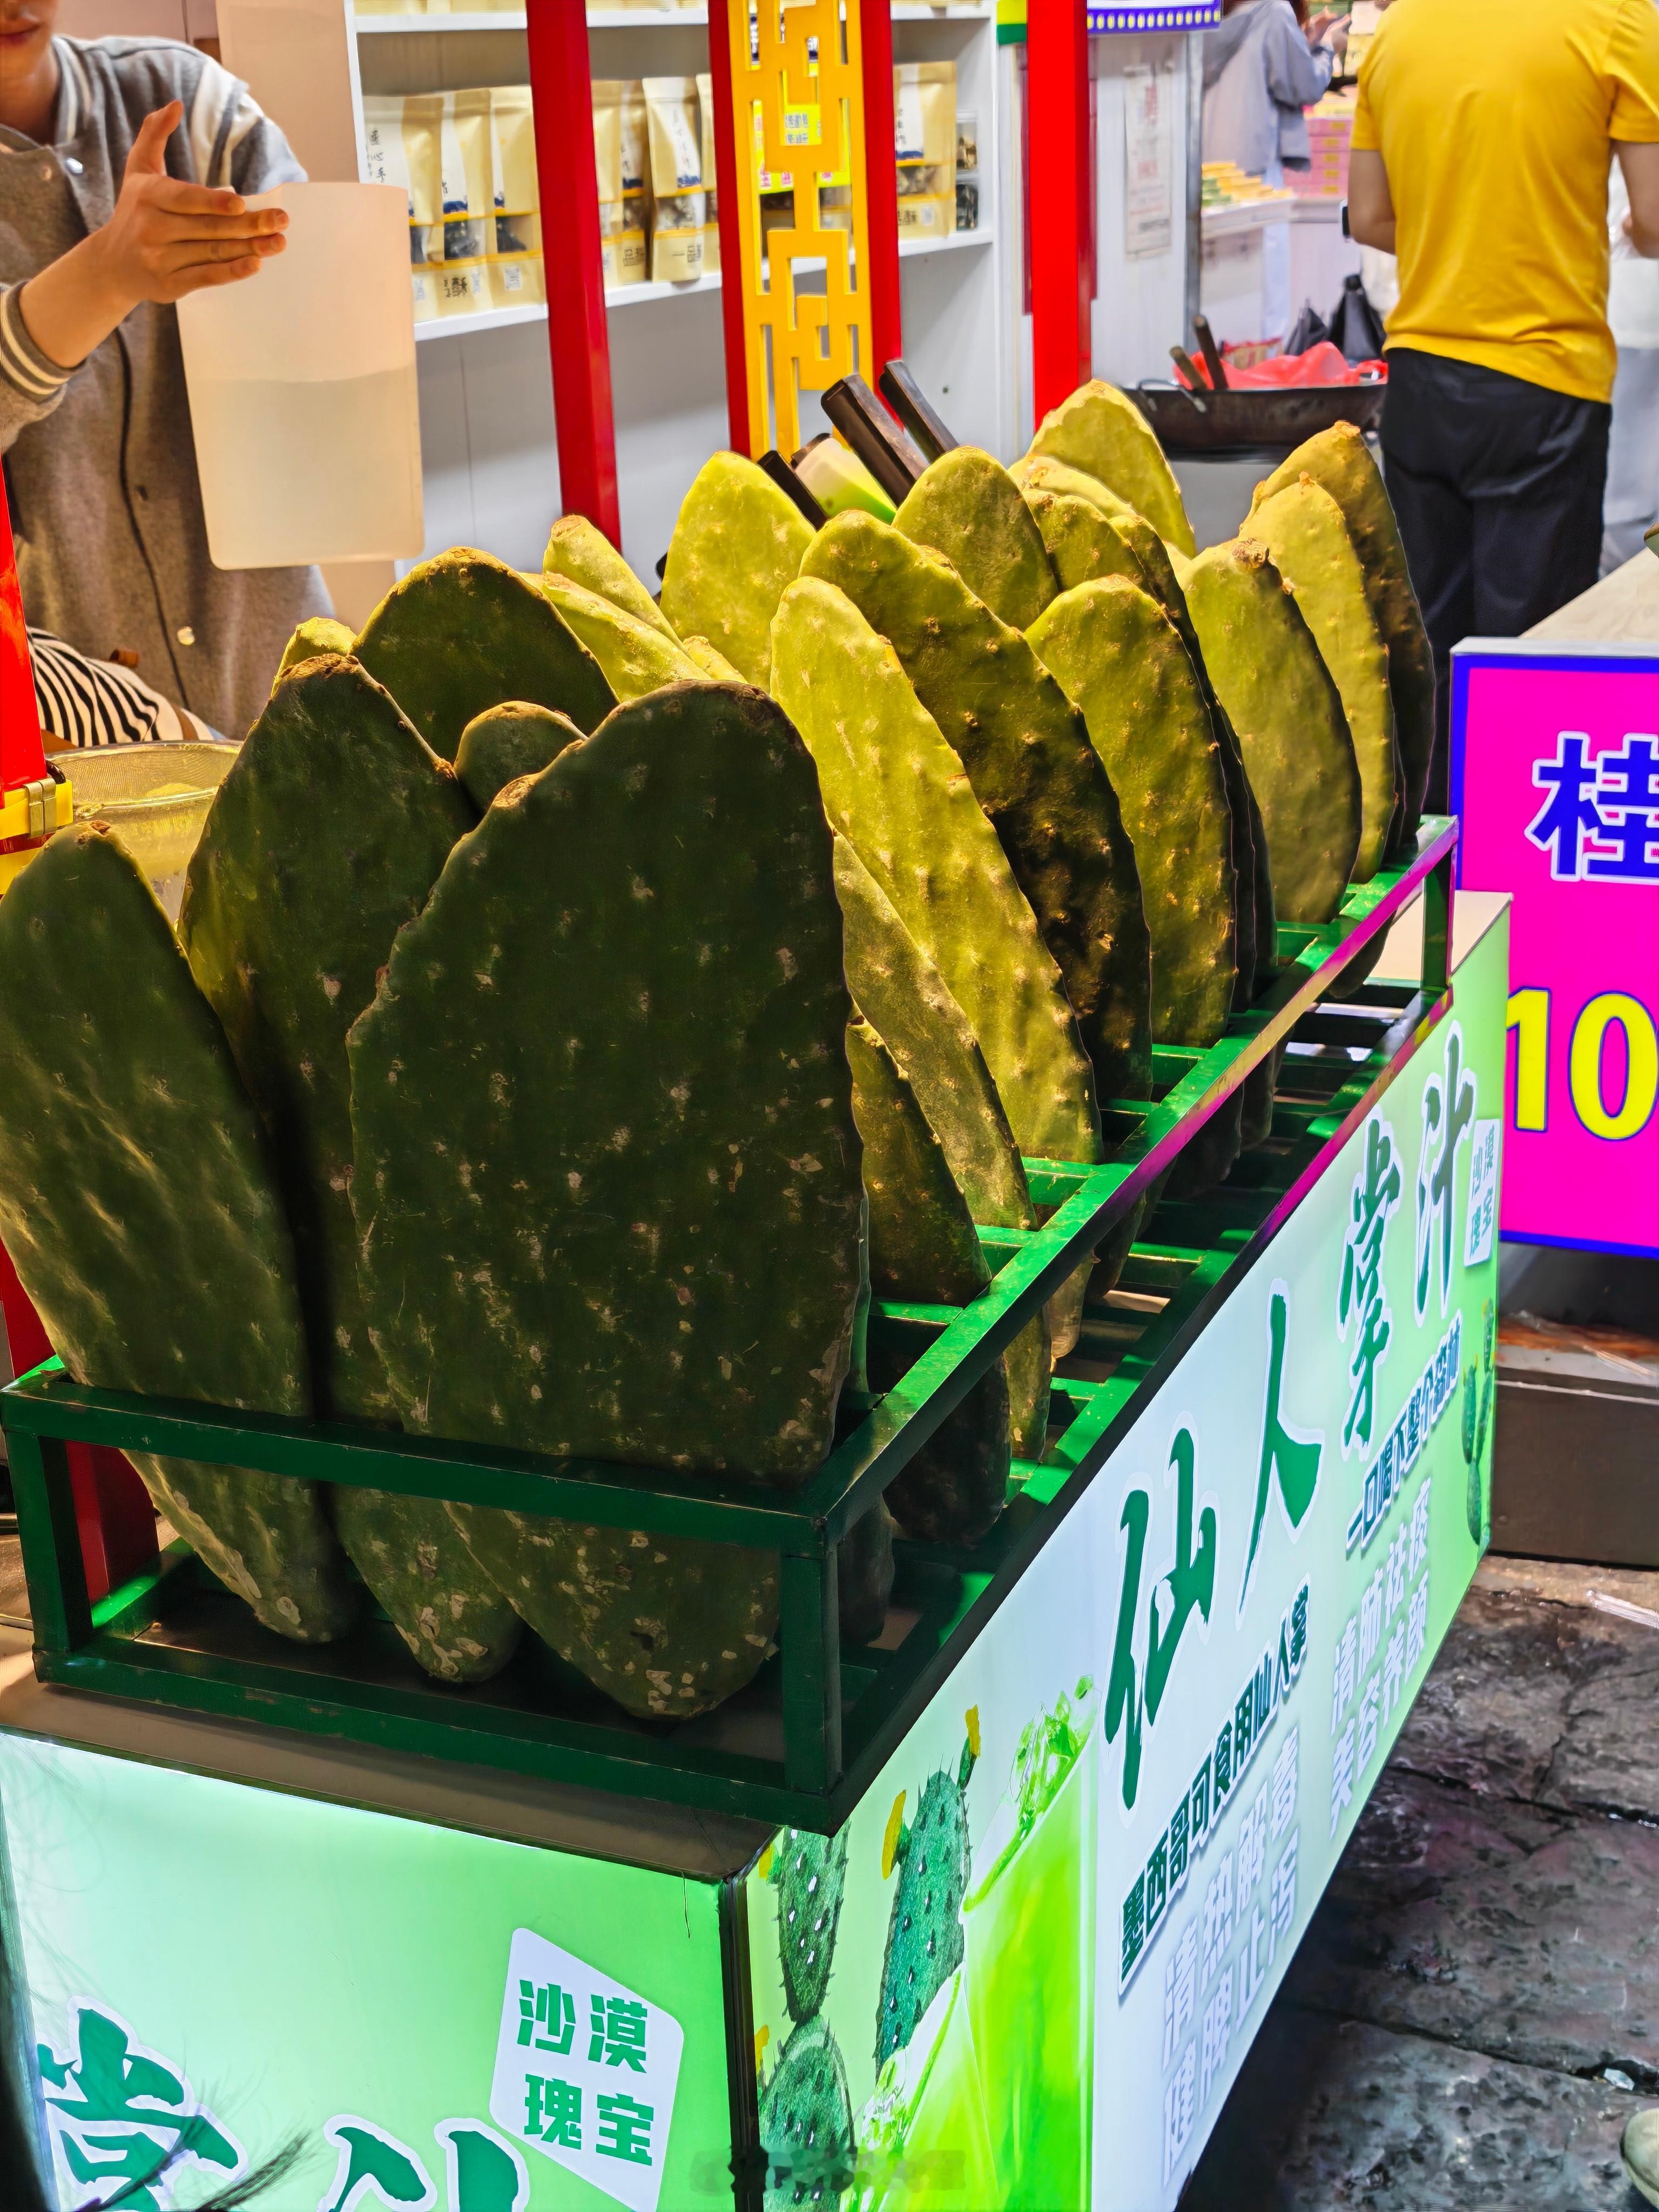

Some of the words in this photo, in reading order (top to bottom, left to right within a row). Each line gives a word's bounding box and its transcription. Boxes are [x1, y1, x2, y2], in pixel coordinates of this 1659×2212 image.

[1526, 731, 1659, 884] 桂
[1505, 986, 1659, 1142] 10
[1330, 1569, 1428, 1841] 美容养颜
[1332, 1478, 1431, 1736] 清肺祛痰
[1121, 1582, 1309, 1984] 墨西哥可食用仙人掌
[1162, 1726, 1298, 2073] 清热解毒
[517, 1979, 648, 2075] 沙漠
[524, 2073, 655, 2167] 瑰宝
[1163, 1827, 1298, 2188] 健脾止泻
